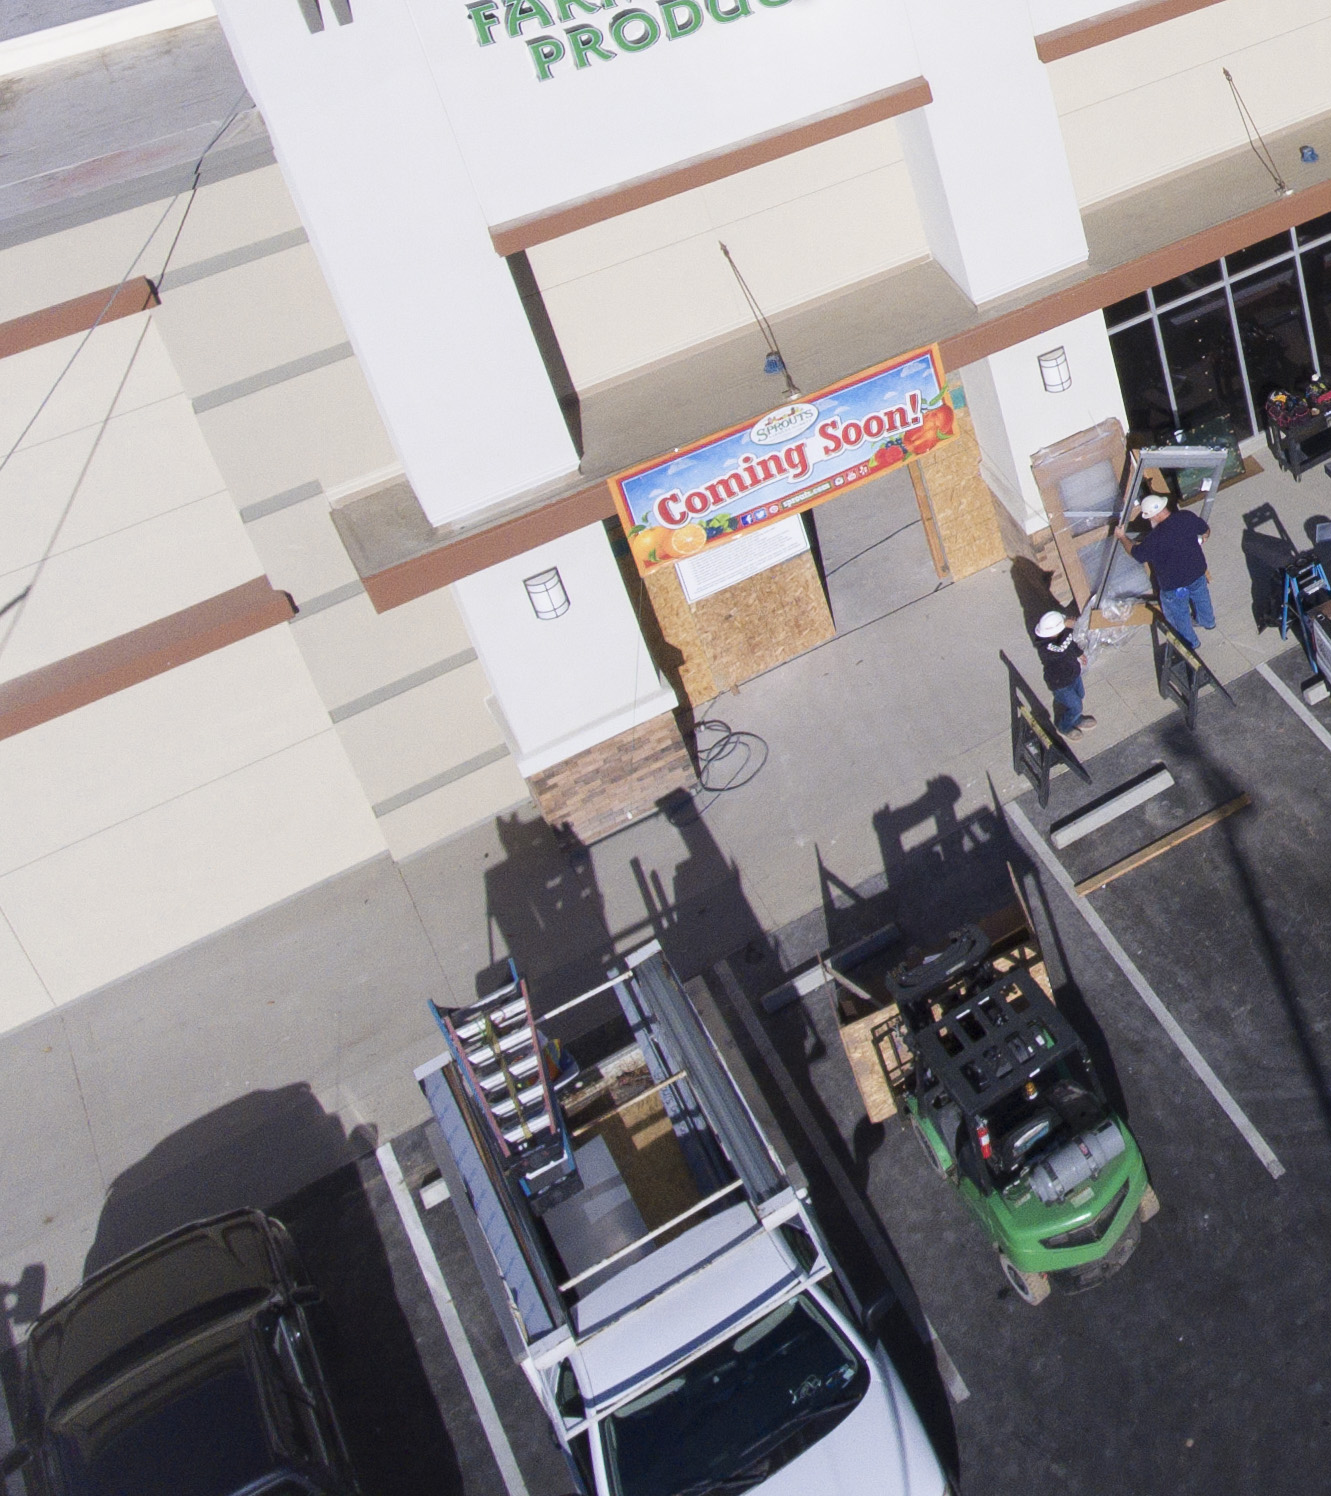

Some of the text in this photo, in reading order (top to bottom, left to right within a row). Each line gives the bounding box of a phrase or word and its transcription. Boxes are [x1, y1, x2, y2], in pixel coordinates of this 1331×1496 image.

[656, 392, 922, 526] Coming Soon!
[756, 408, 814, 442] SPROUTS
